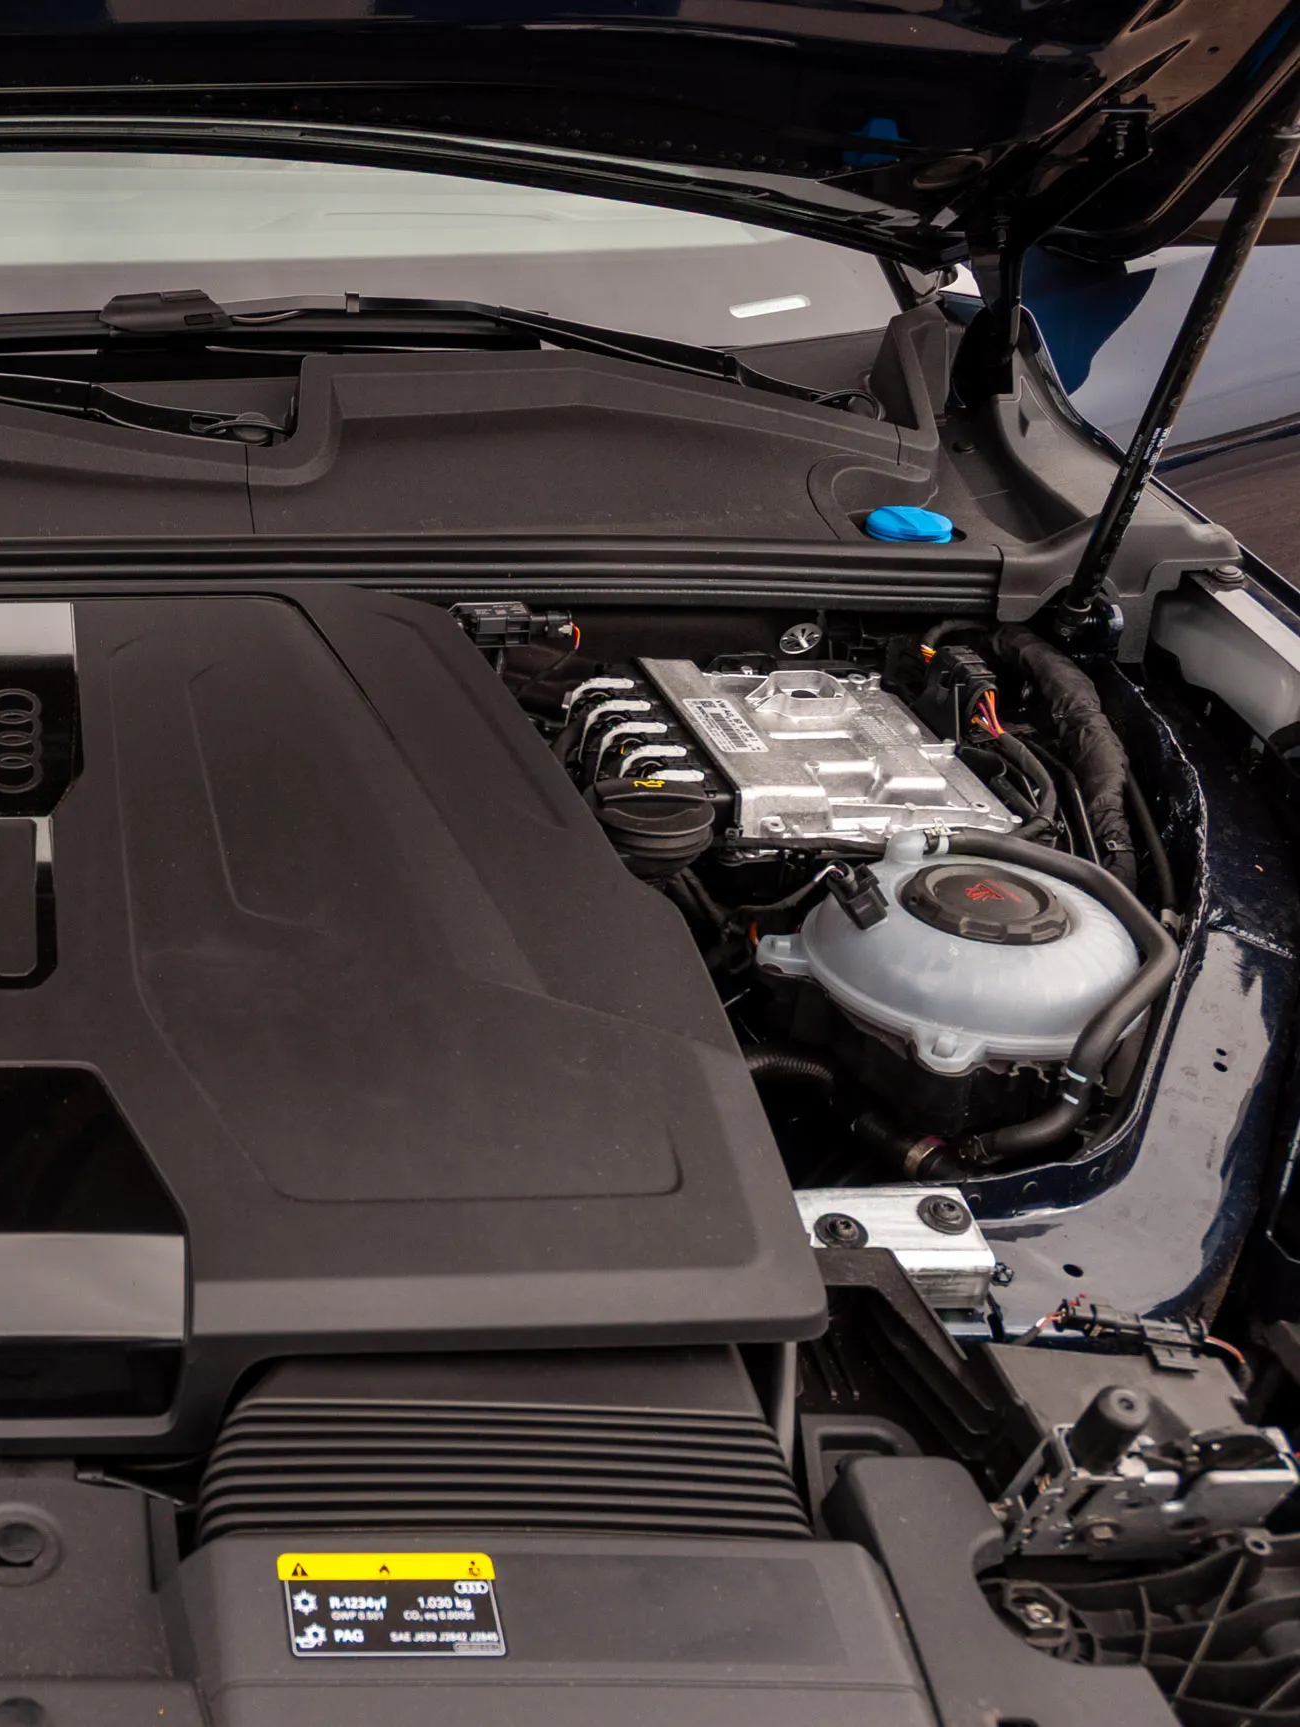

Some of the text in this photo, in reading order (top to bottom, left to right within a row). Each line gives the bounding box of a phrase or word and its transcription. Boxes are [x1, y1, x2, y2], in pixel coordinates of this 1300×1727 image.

[328, 1595, 388, 1611] R-1234yf
[454, 1596, 473, 1611] kg
[330, 1610, 357, 1621] GWP
[333, 1628, 365, 1643] PAG
[389, 1631, 412, 1643] SAE
